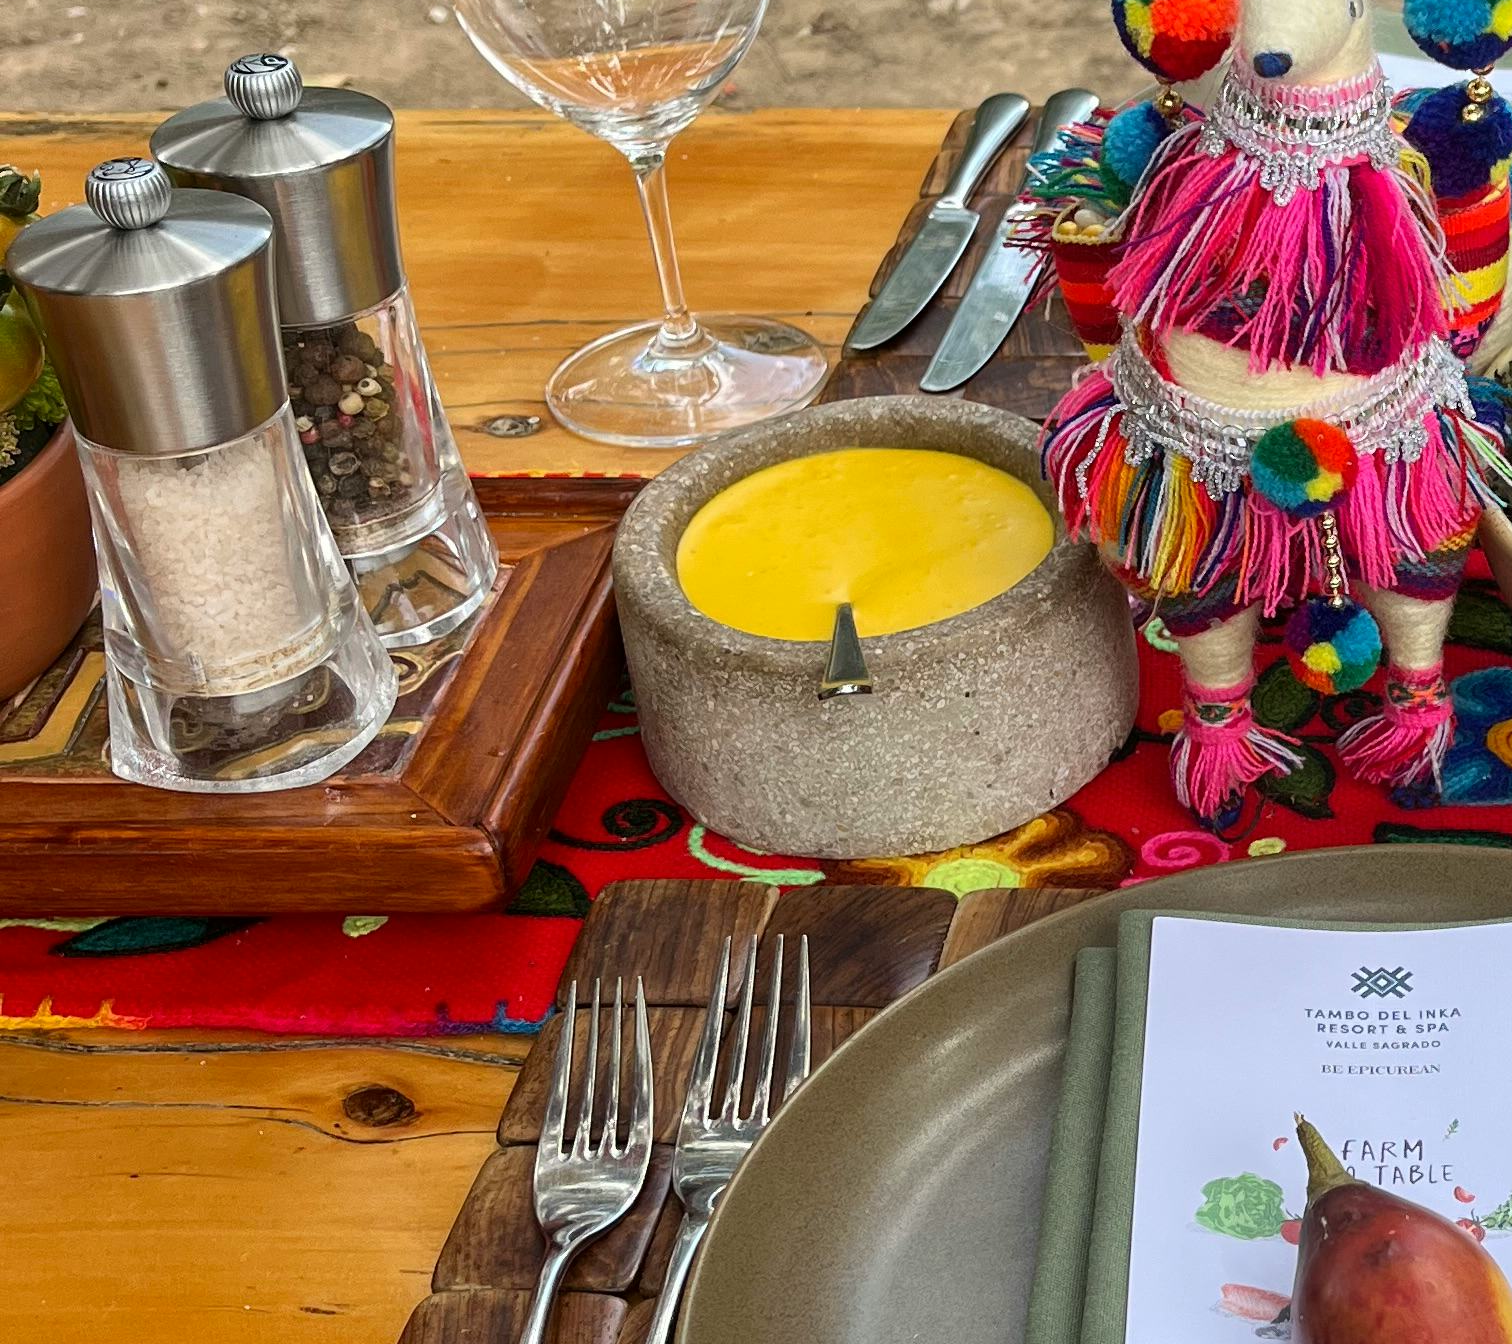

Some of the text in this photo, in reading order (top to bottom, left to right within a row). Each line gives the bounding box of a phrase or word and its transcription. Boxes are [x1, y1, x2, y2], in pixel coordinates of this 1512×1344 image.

[1305, 1007, 1461, 1020] TAMBO DEL INKA
[1317, 1022, 1449, 1034] RESORT & SPA
[1326, 1040, 1441, 1050] VALLE SAGRADO
[1321, 1063, 1441, 1075] BE EPICUREAN
[1342, 1139, 1423, 1163] FARM
[1374, 1164, 1453, 1185] TABLE
